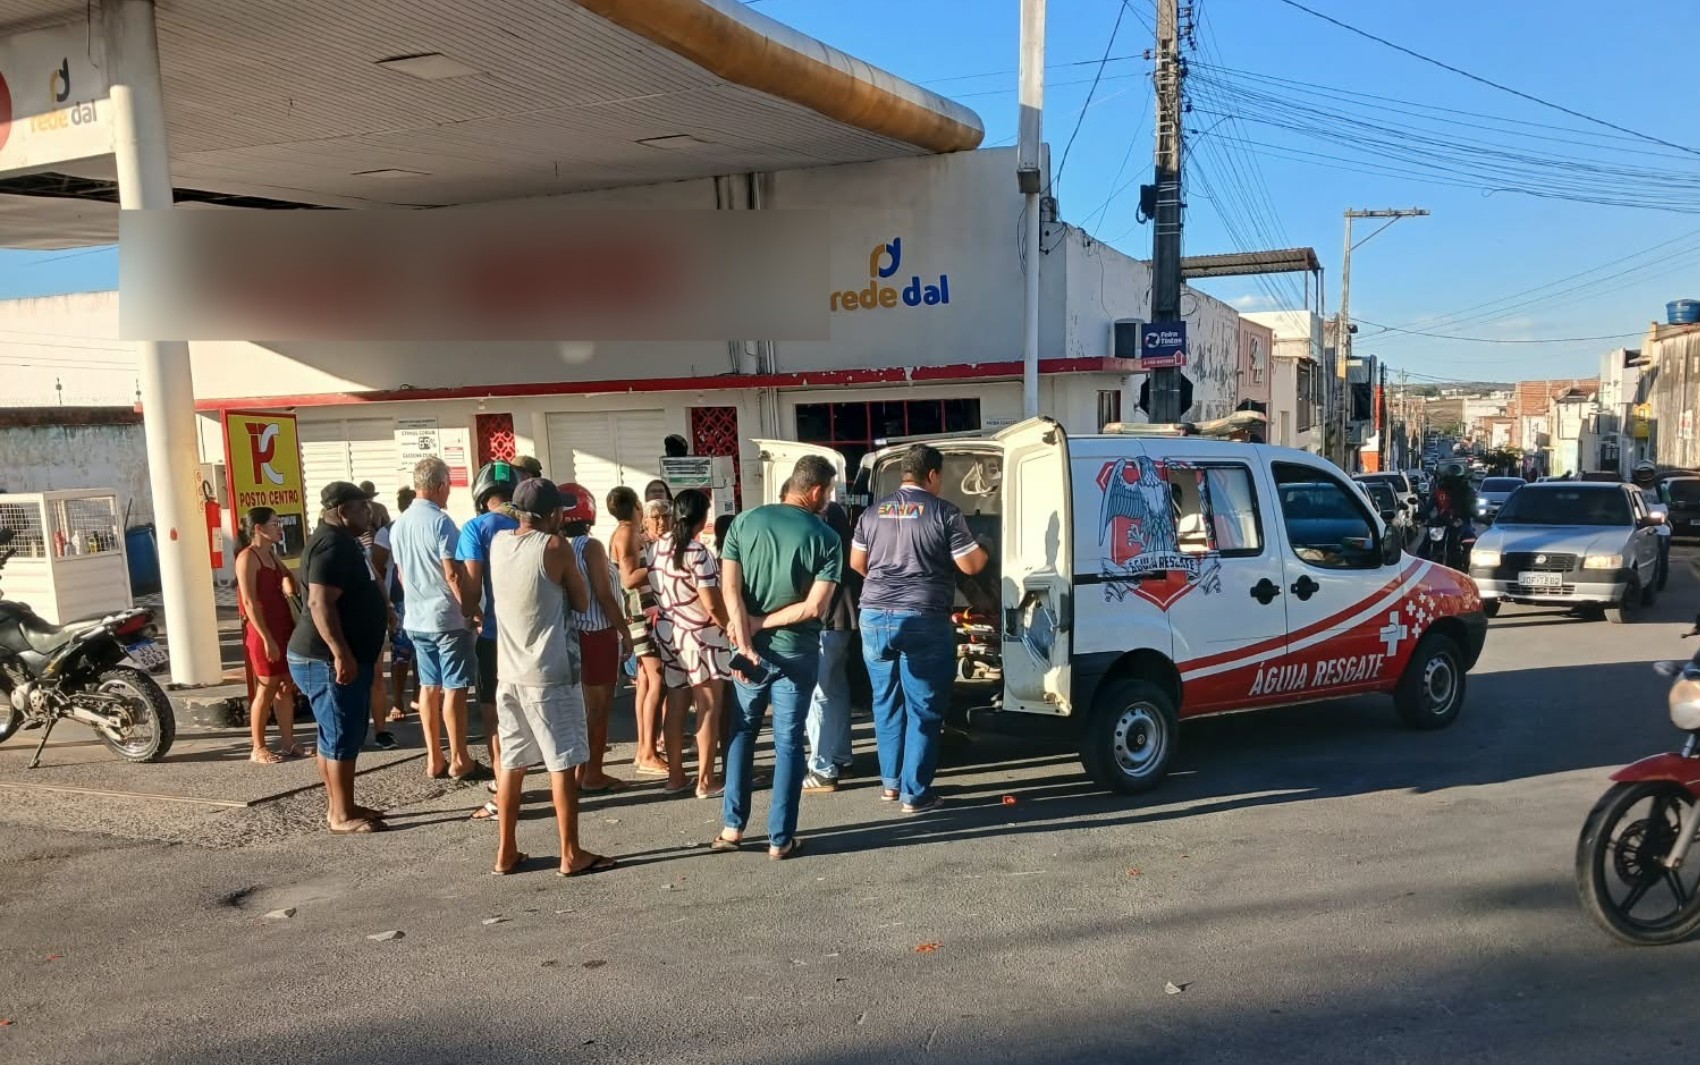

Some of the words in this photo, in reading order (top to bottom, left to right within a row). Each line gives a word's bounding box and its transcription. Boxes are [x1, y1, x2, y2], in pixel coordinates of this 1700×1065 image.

[71, 98, 97, 126] dal
[830, 280, 898, 312] rede
[902, 274, 949, 306] dal
[240, 492, 265, 506] POSTO
[269, 490, 298, 505] CENTRO
[1249, 662, 1308, 696] ÁGUIA
[1311, 653, 1386, 687] RESGATE
